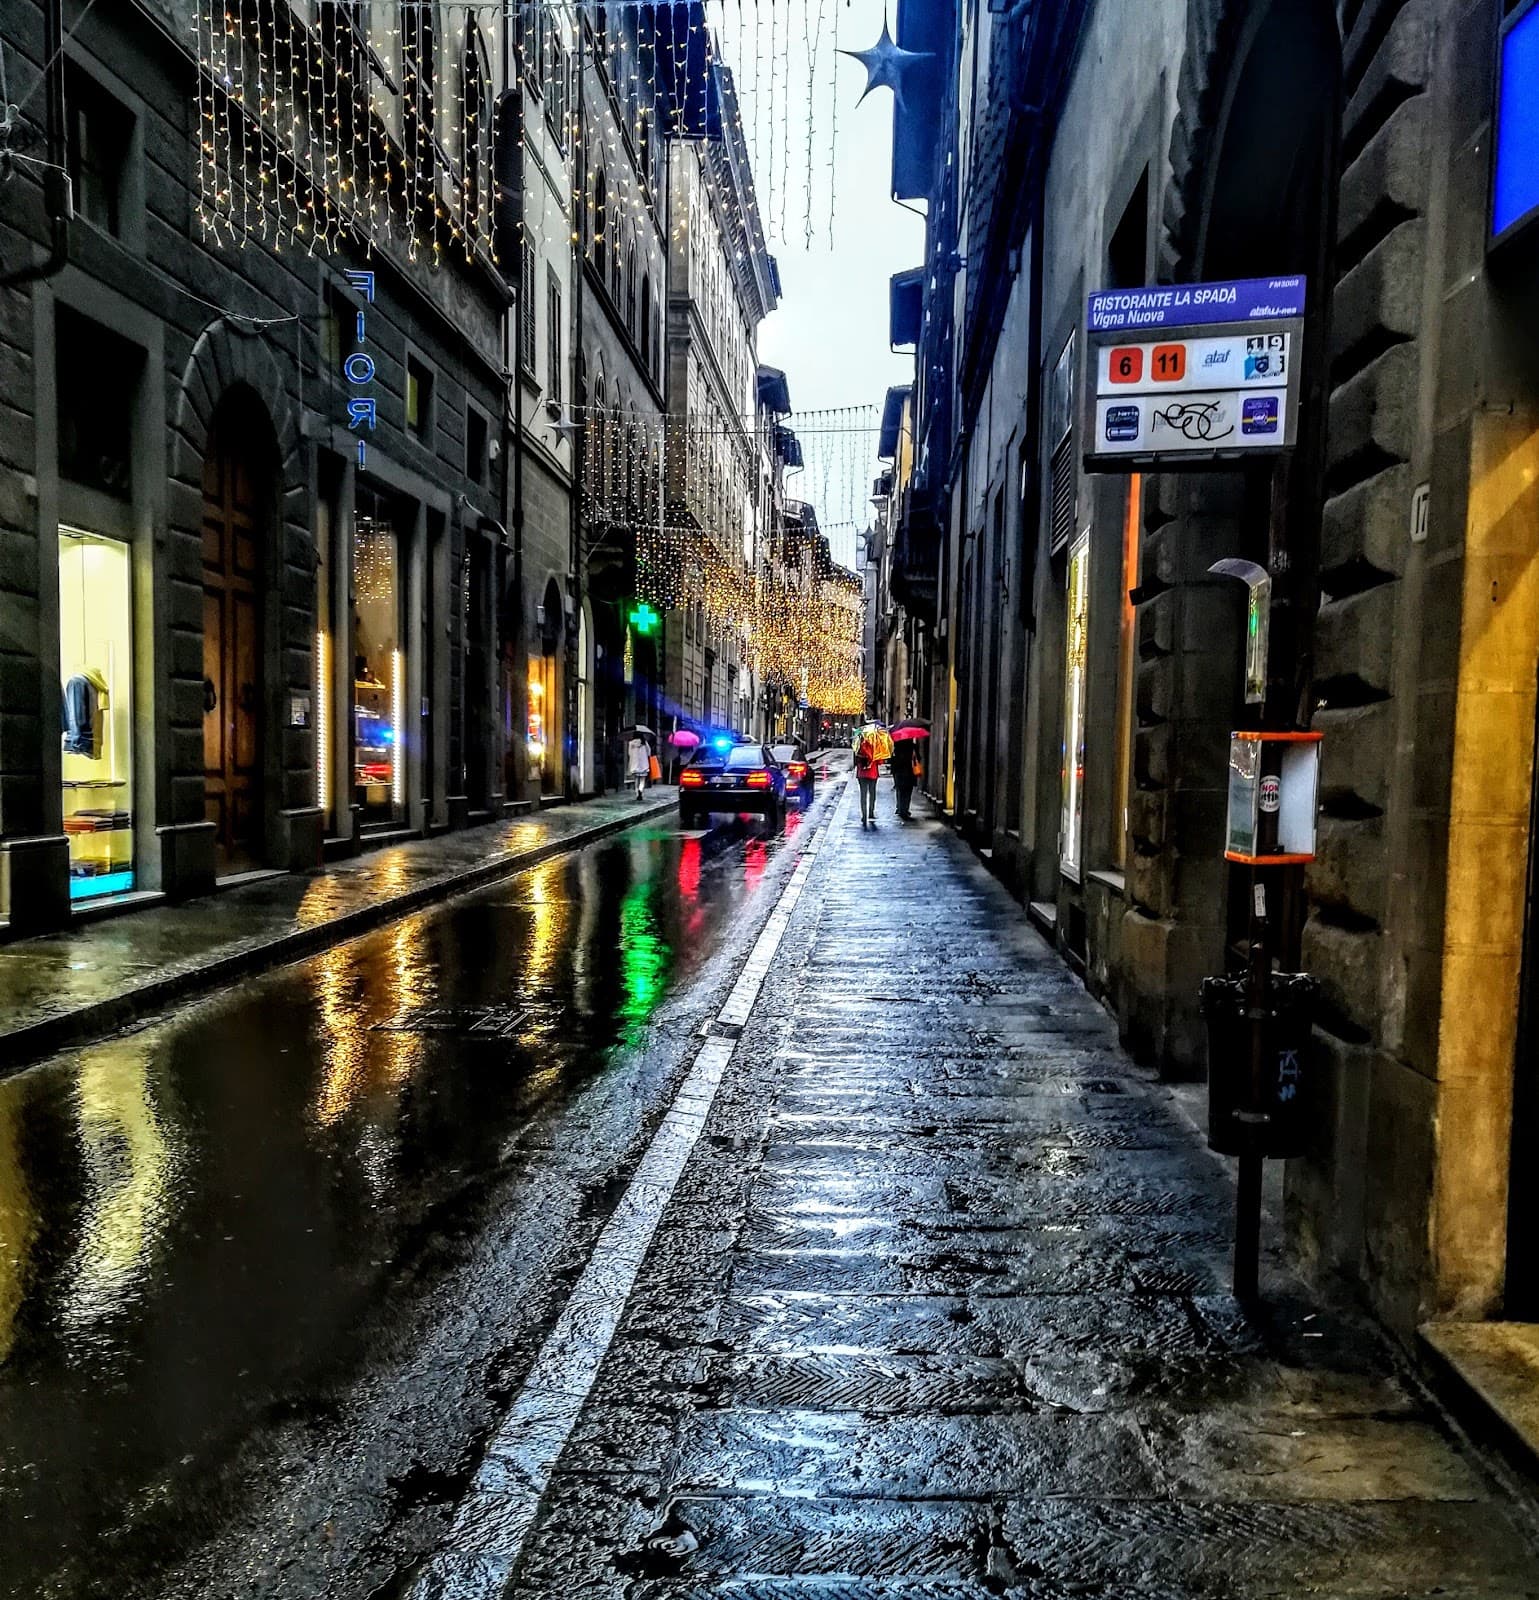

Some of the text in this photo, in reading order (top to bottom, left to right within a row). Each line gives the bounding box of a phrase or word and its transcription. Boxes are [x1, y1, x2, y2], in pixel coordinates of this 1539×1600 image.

[1093, 287, 1237, 312] RISTORANTE LA SPADA
[1093, 309, 1165, 328] Vigna Nuova
[1119, 352, 1179, 377] 6 11
